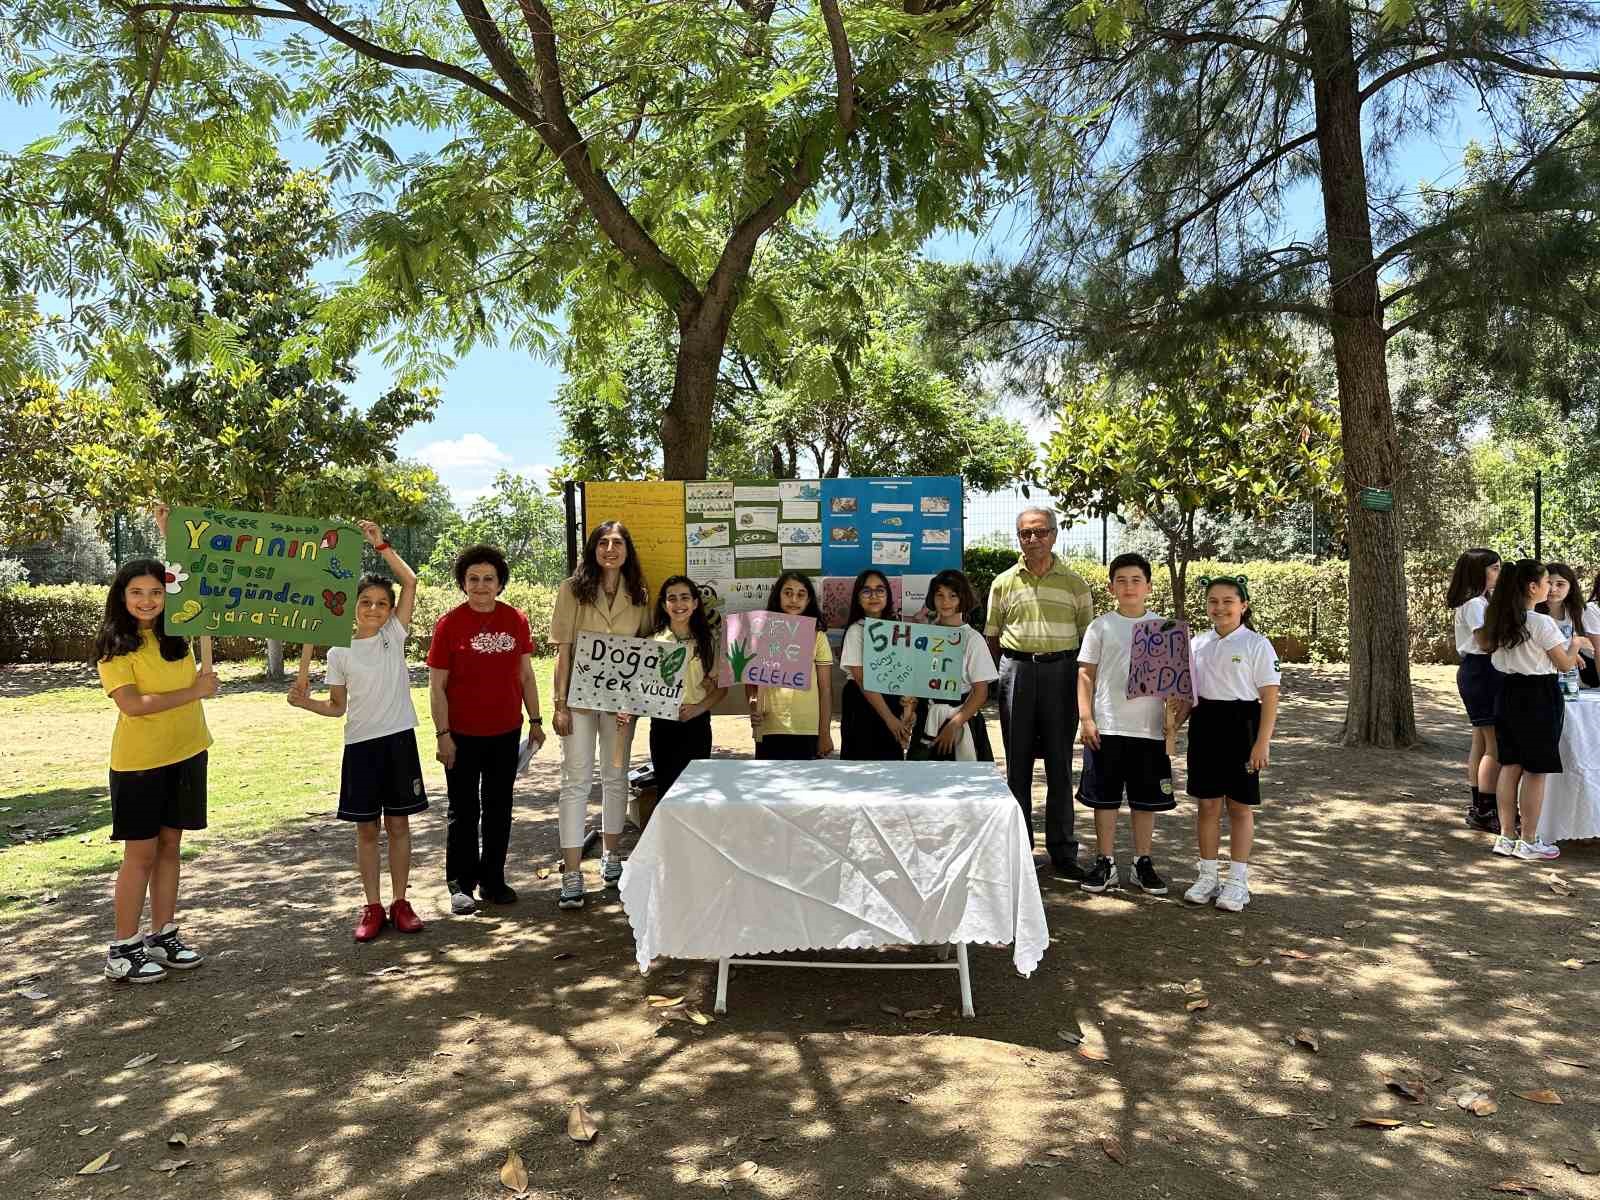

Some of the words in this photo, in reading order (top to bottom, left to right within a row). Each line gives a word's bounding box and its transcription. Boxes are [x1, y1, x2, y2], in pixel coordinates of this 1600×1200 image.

[184, 520, 318, 560] Yarının
[190, 553, 275, 582] doğası
[200, 577, 315, 609] bugünden
[206, 608, 323, 632] yaratılır
[576, 662, 591, 675] ile
[592, 639, 659, 679] Doğa
[593, 671, 631, 692] tek
[641, 680, 683, 699] vücut
[748, 666, 804, 686] ELELE
